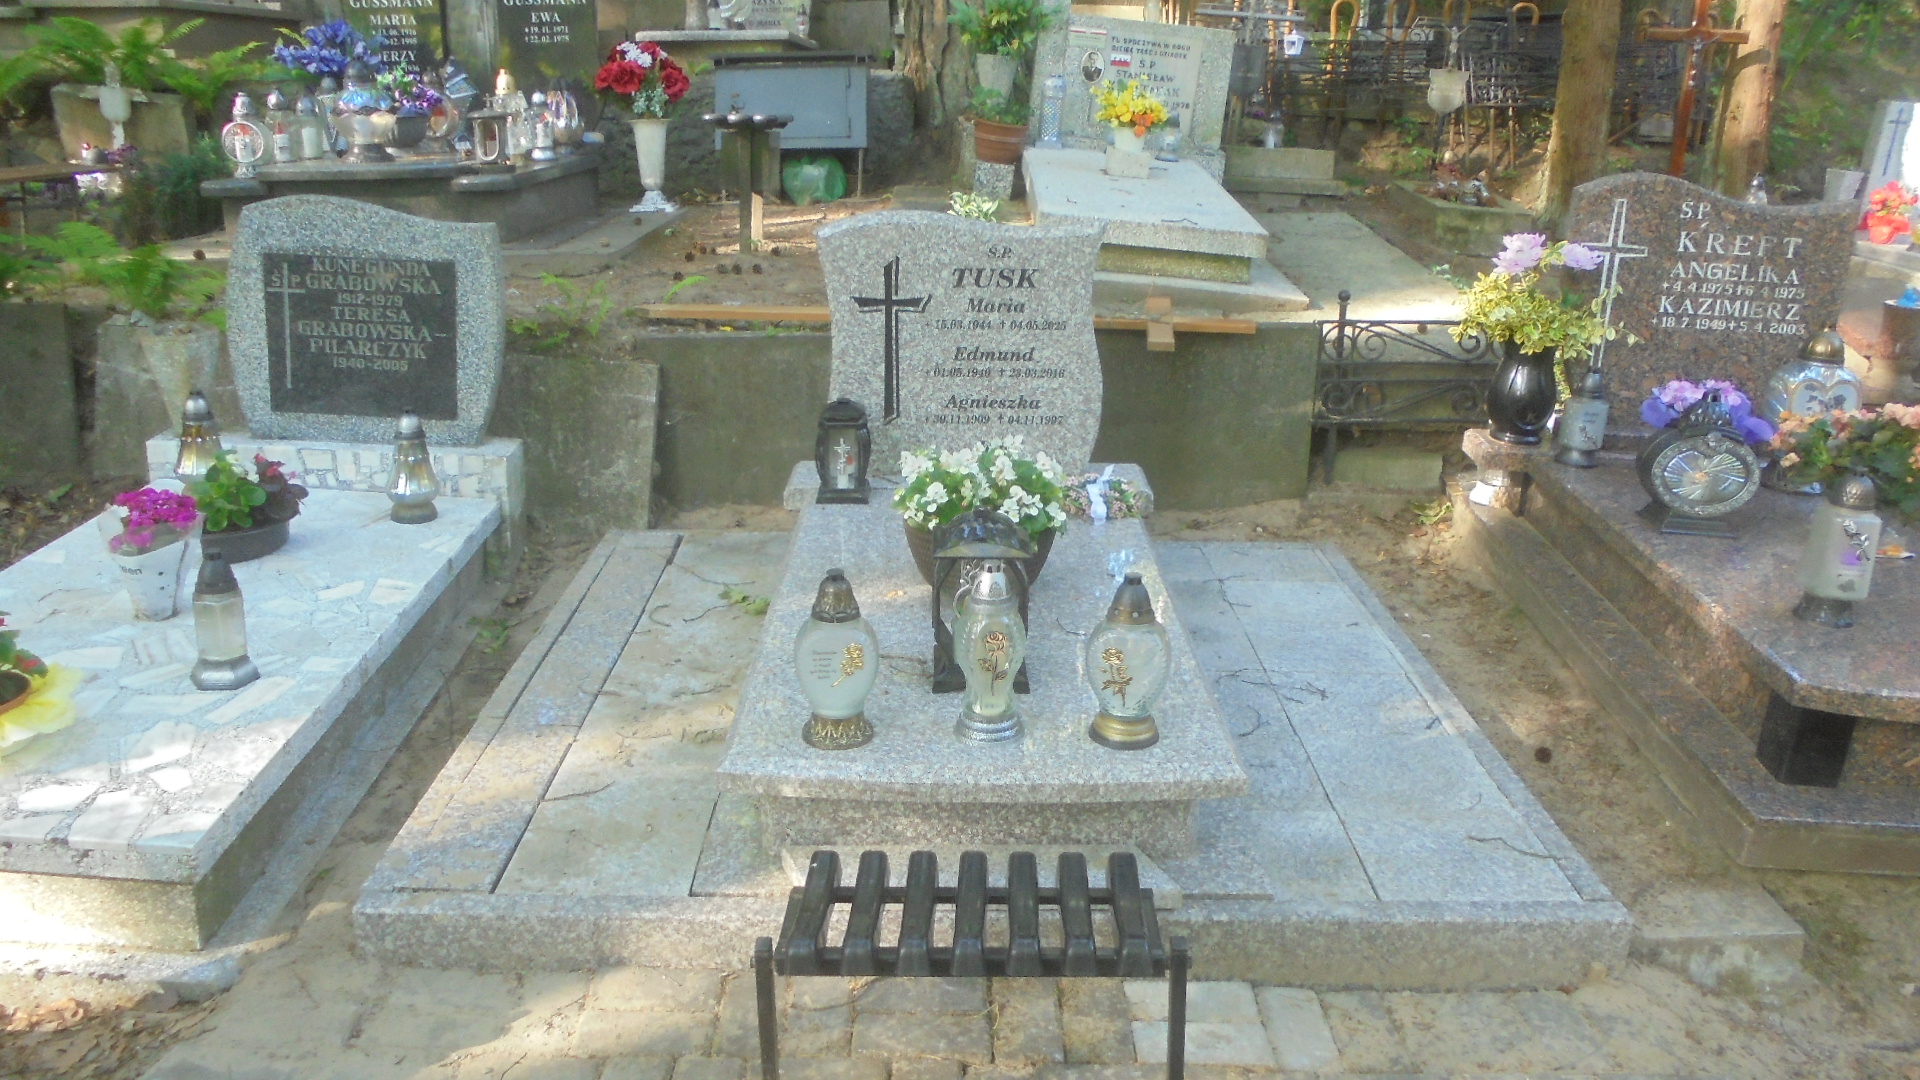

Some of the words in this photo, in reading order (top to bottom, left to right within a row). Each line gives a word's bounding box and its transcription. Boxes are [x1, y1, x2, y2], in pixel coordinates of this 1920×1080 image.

[370, 15, 417, 26] MARTA
[531, 12, 561, 23] EWA
[1677, 230, 1803, 259] KREFT
[311, 257, 431, 277] KUNEGUNDA
[1670, 260, 1800, 285] ANGELIKA
[305, 273, 442, 295] GRABOWSKA
[952, 267, 1039, 289] TUSK
[336, 292, 404, 308] 1912-1979
[966, 297, 1026, 314] Maria
[1659, 295, 1800, 321] KAZIMIERZ
[330, 305, 411, 324] TERESA
[308, 337, 428, 359] PILARCZYK
[953, 346, 1036, 362] Edmund
[332, 356, 409, 372] 1940-2005
[944, 394, 1042, 412] Agnieszka
